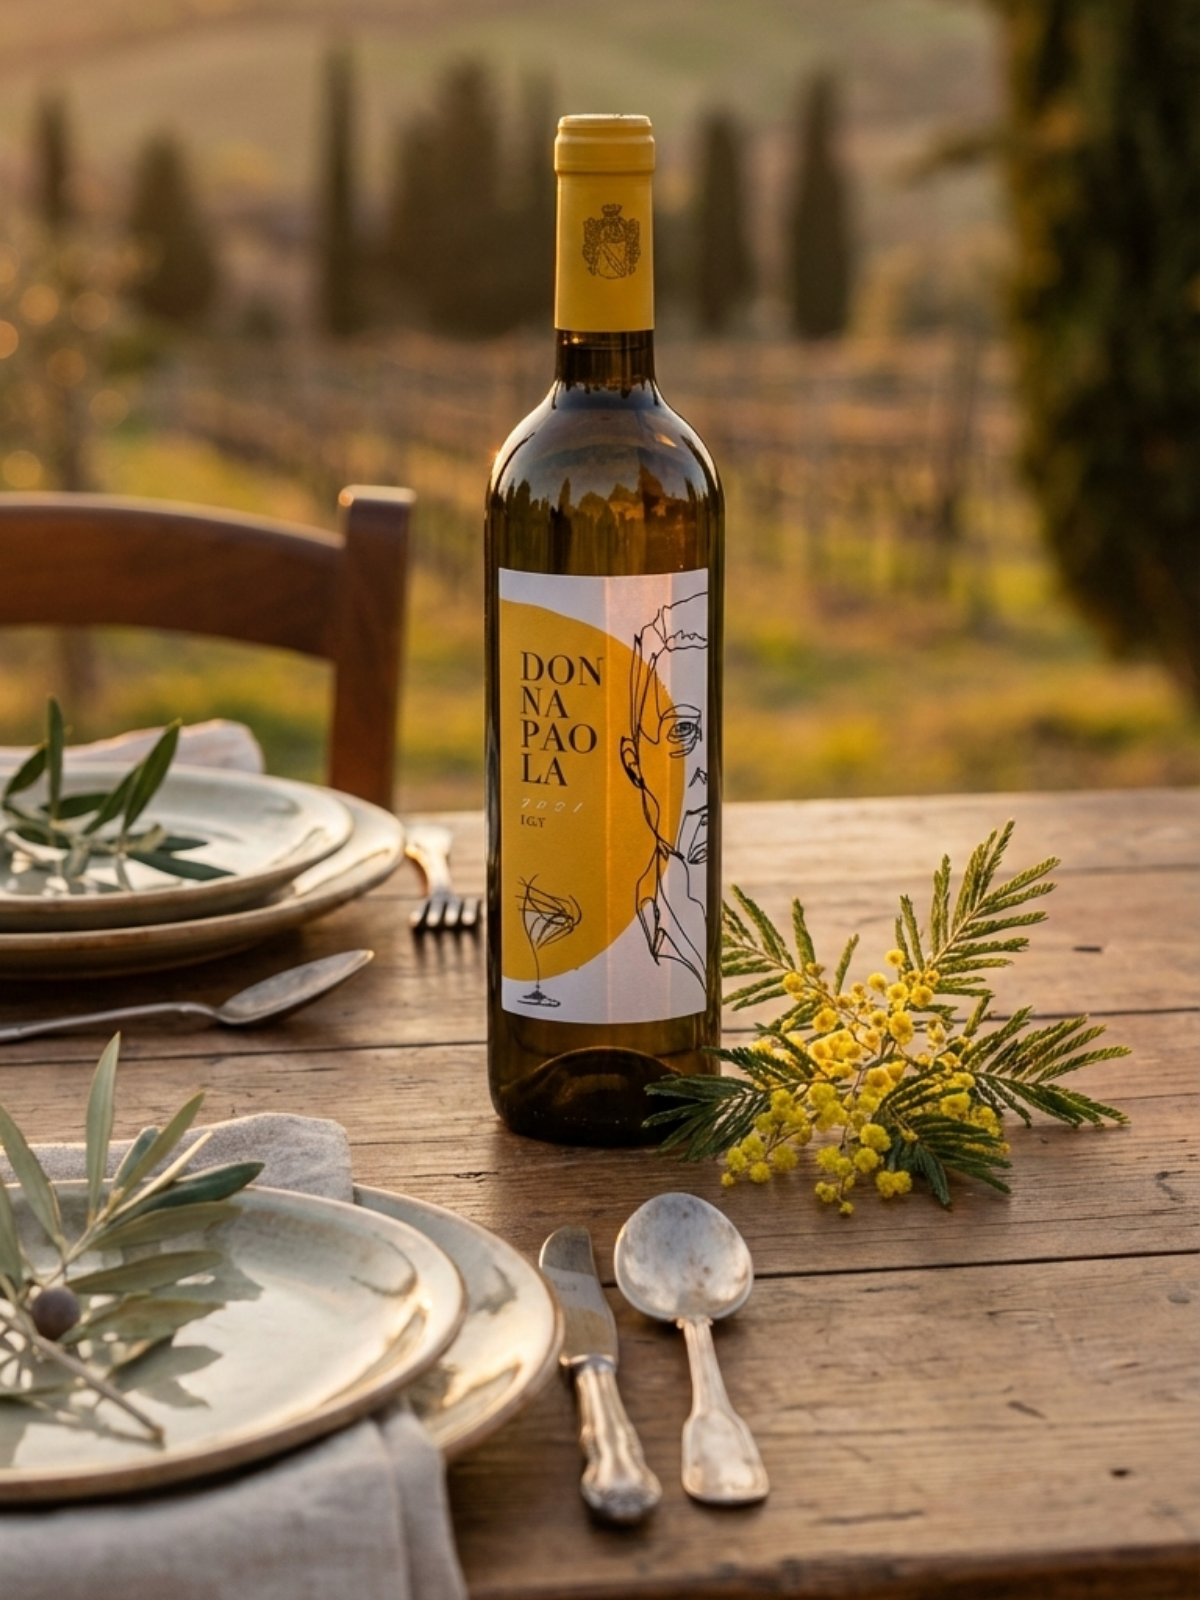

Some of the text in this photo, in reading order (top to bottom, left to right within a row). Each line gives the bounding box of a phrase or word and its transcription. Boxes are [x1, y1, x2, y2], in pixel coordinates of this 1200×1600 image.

[520, 651, 604, 686] DON
[520, 686, 569, 718] NA
[520, 718, 597, 754] PAO
[521, 753, 568, 786] LA
